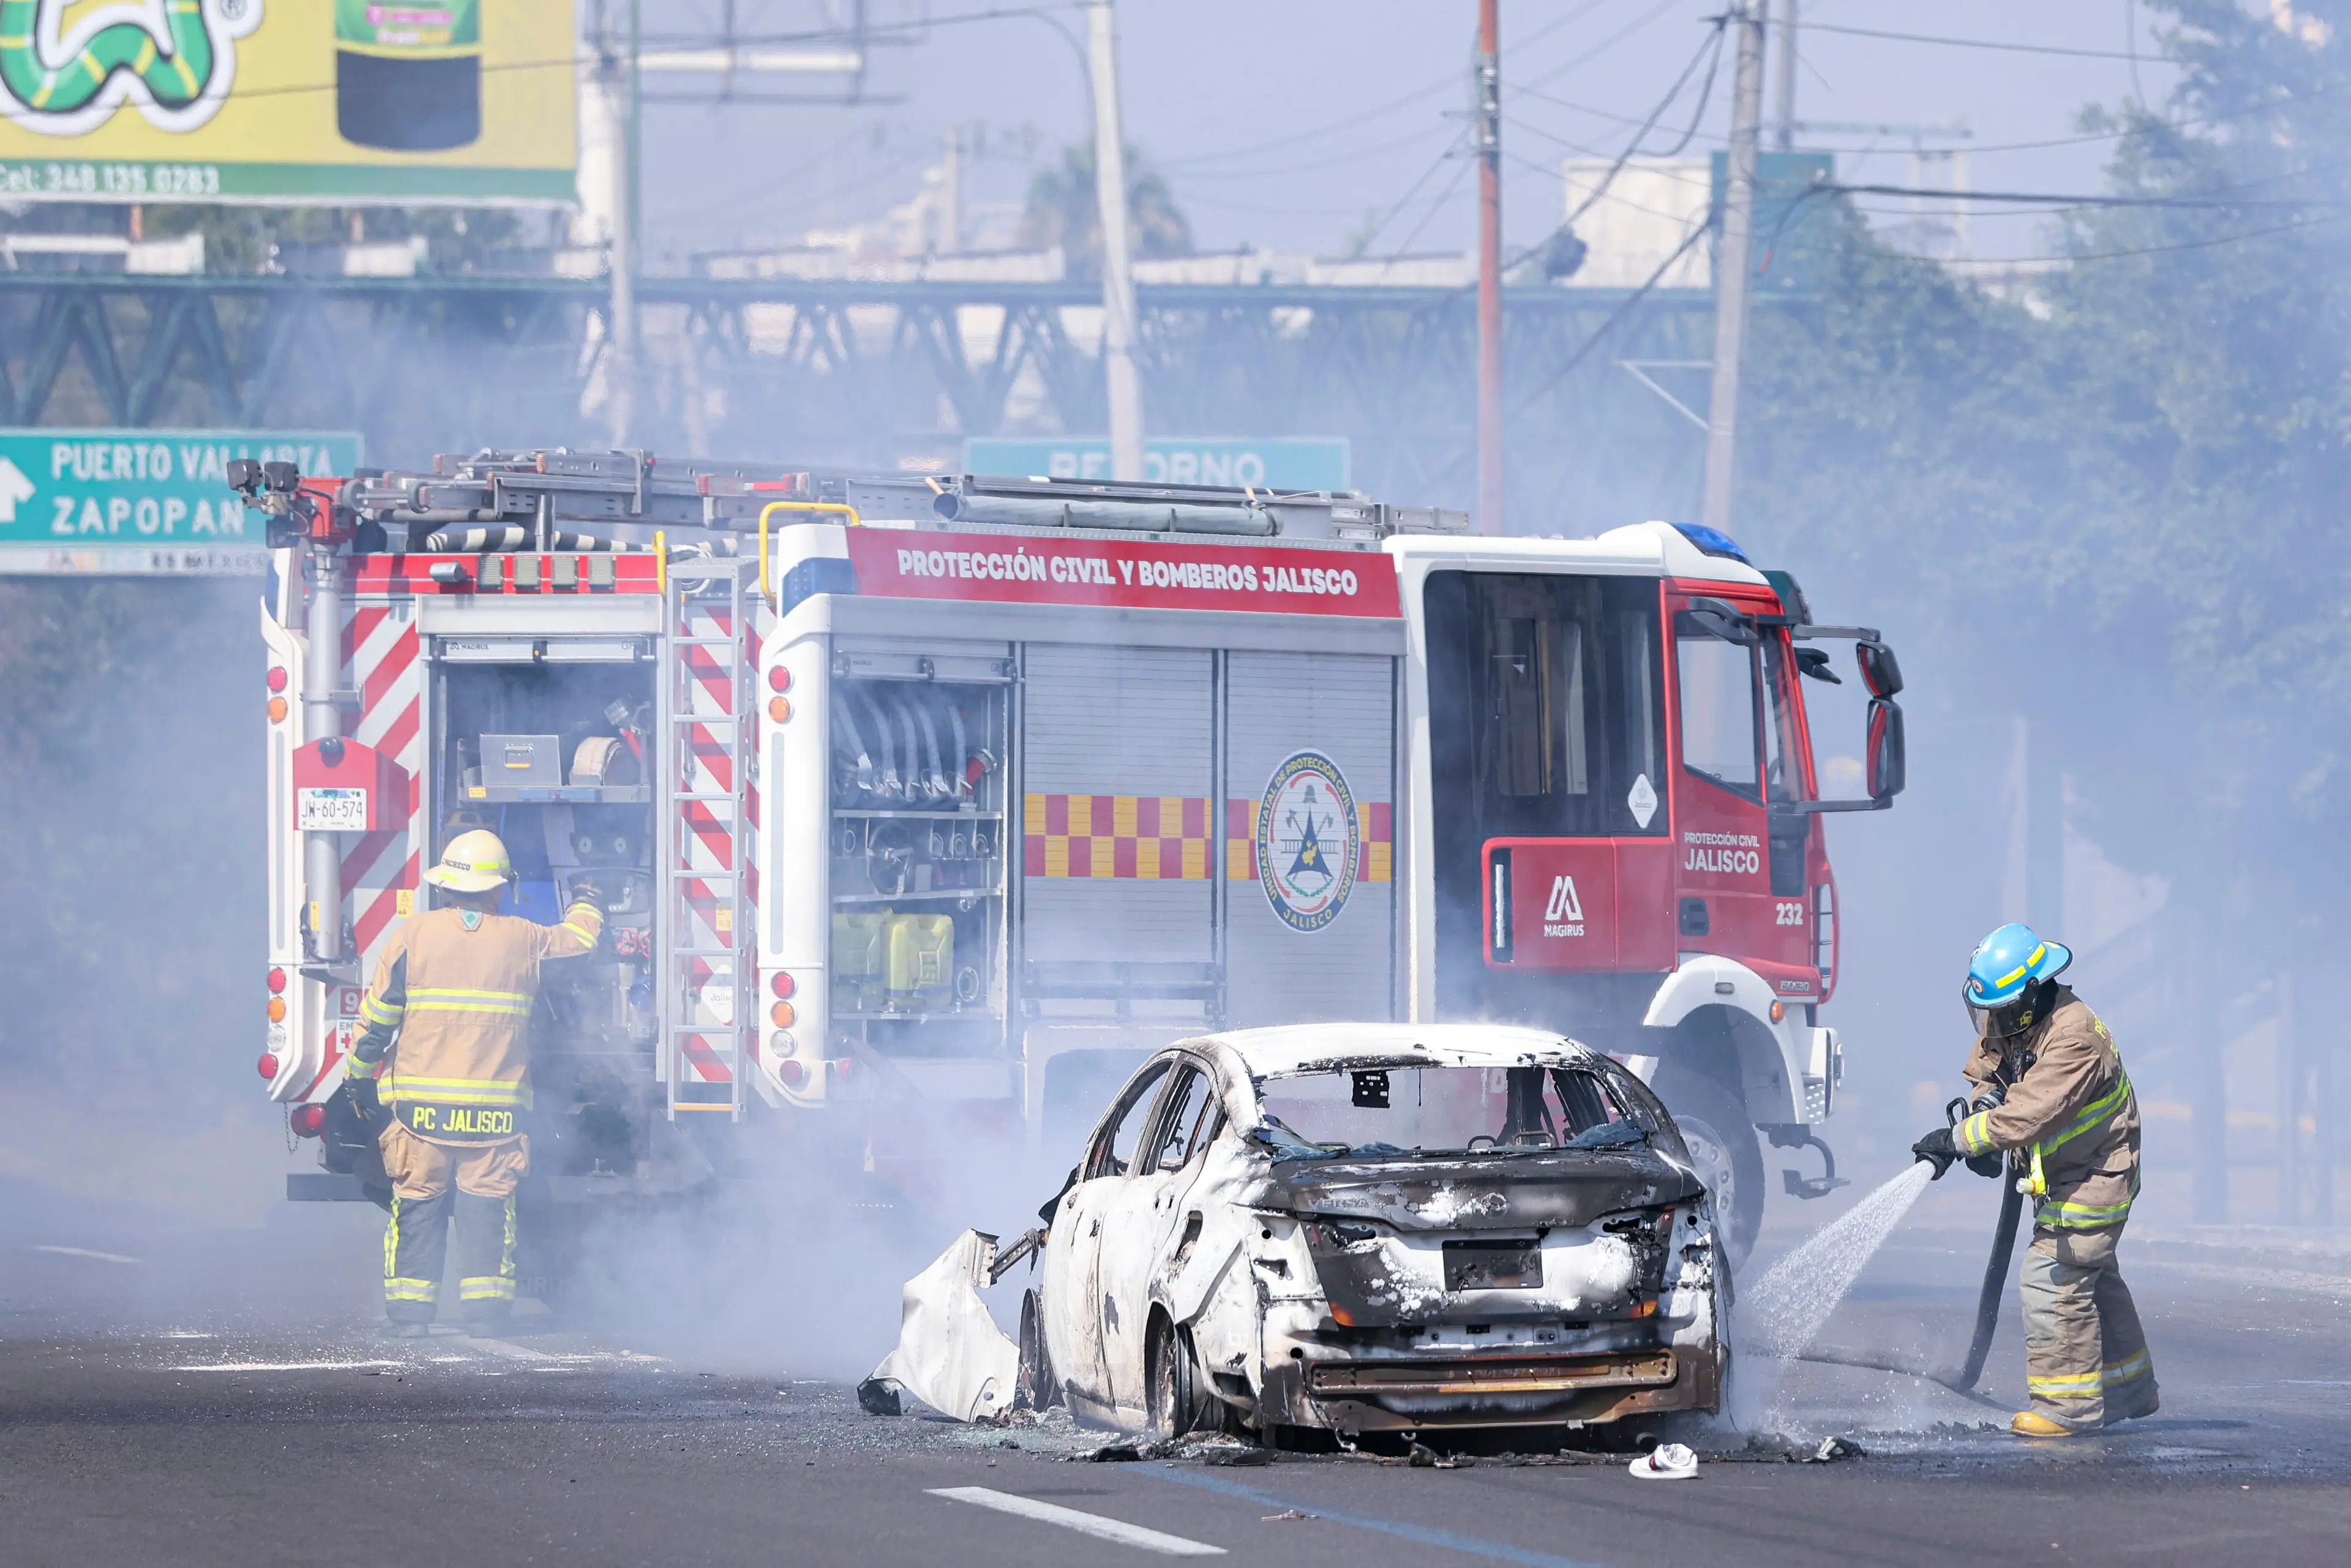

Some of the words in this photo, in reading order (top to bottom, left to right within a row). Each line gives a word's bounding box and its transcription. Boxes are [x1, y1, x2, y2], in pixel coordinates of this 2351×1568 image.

[102, 163, 148, 193] 135
[51, 443, 172, 481] PUERTO
[1049, 451, 1265, 487] REORNO
[51, 496, 244, 535] ZAPOPAN
[898, 546, 1046, 581] PROTECCIÓN
[1051, 557, 1116, 584] CIVIL
[1117, 560, 1134, 585] Y
[1138, 561, 1258, 591] BOMBEROS
[1262, 566, 1357, 596] JALISCO
[1275, 770, 1286, 787] DE
[1286, 757, 1337, 781] PROTECCIÓN
[1260, 788, 1278, 843] ESTATAL
[1684, 831, 1738, 846] PROTECCIÓN
[1739, 835, 1760, 847] CIVIL
[1259, 847, 1277, 901] UNIDAD
[1685, 849, 1760, 874] JALISCO
[1283, 909, 1332, 928] JALISCO
[1776, 902, 1804, 925] 232
[1544, 924, 1585, 937] MAGIRUS
[413, 1106, 437, 1131] PC
[442, 1109, 513, 1133] JALISCO
